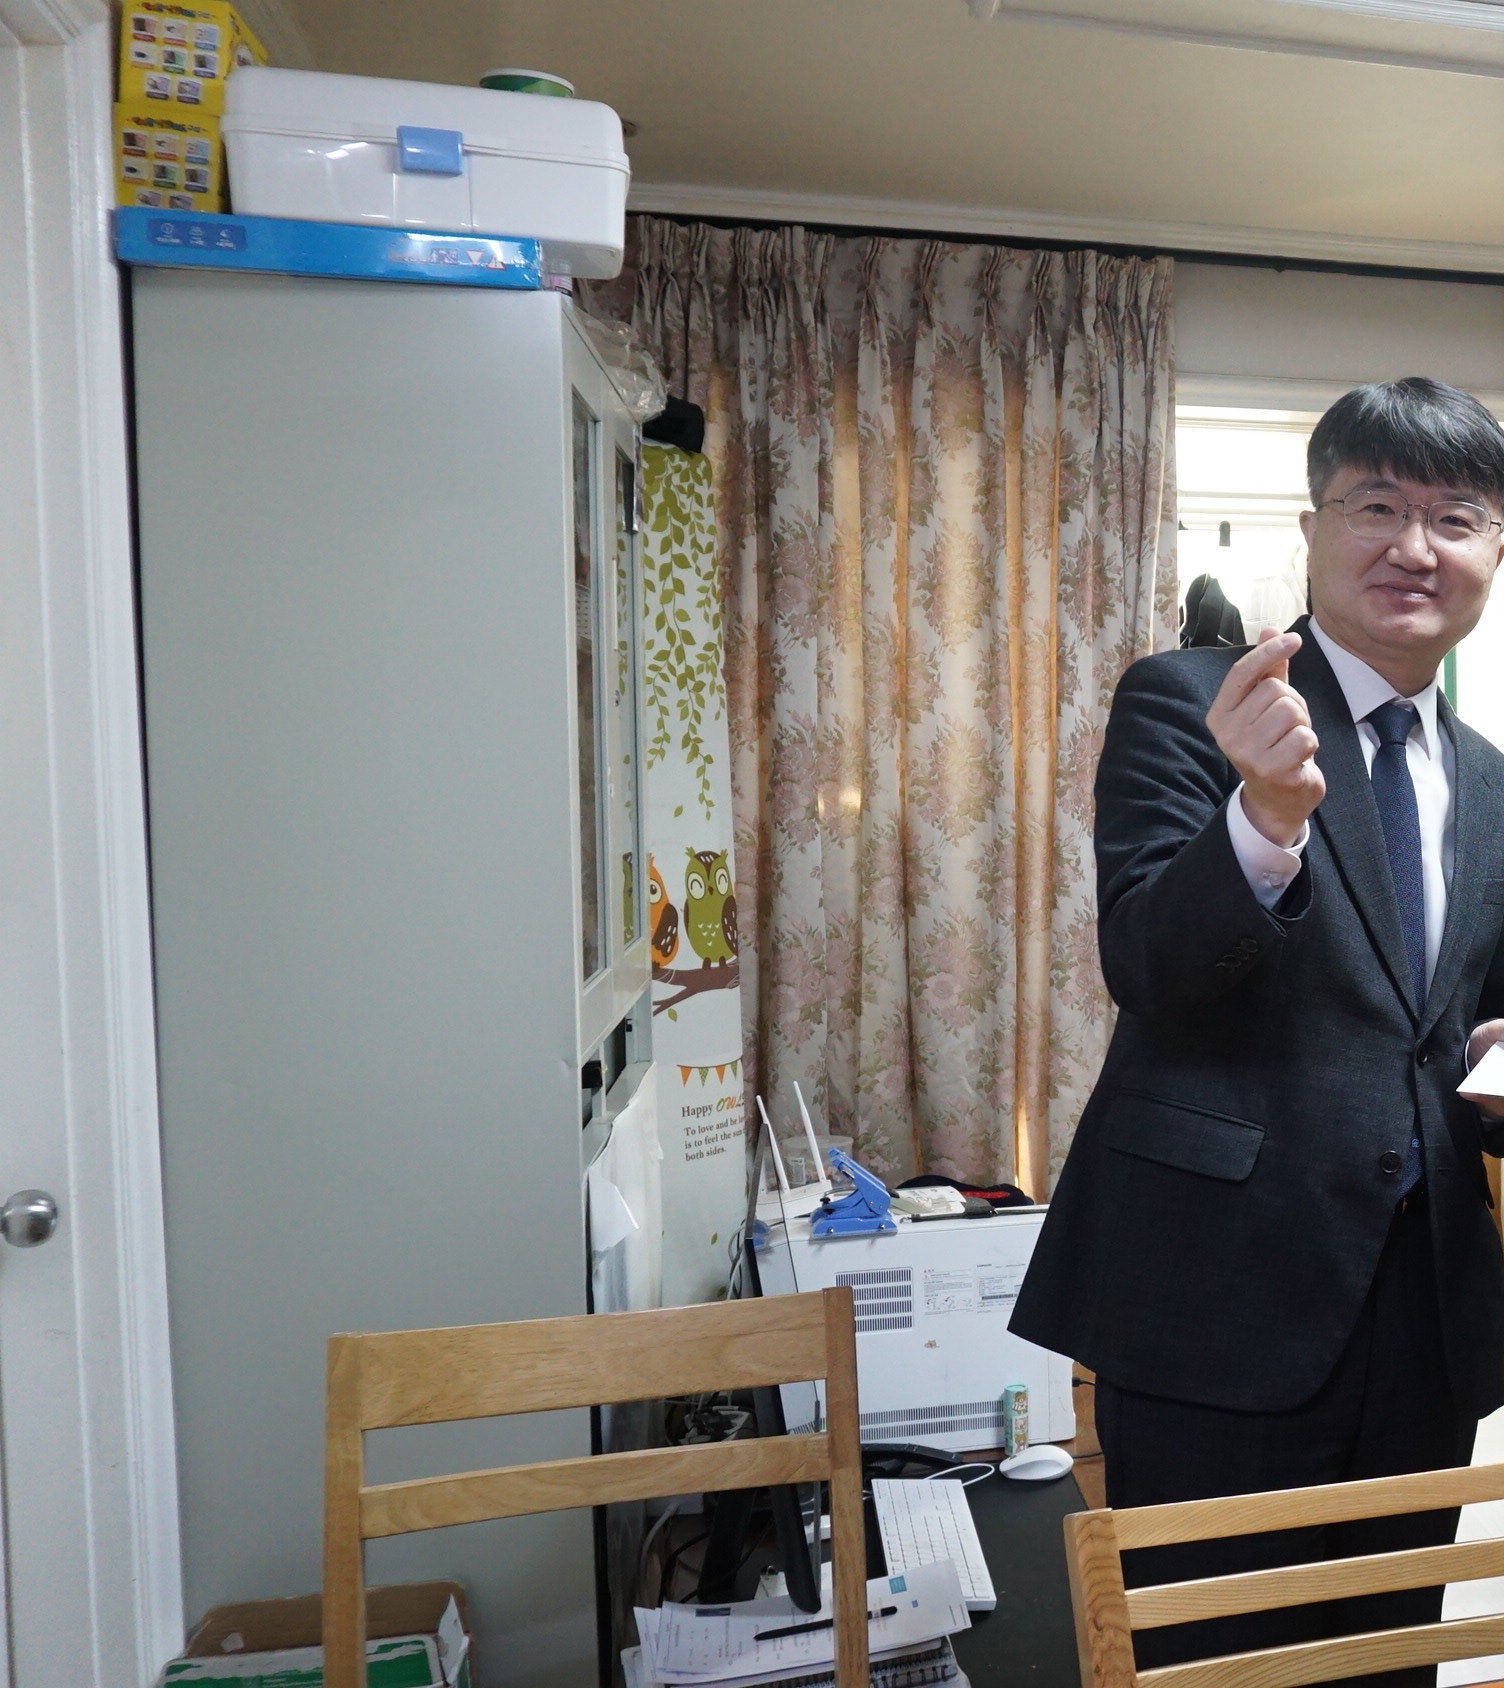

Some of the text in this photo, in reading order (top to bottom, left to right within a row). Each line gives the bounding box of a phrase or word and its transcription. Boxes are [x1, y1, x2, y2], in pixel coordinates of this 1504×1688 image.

[681, 1104, 713, 1119] Happy
[684, 1127, 696, 1137] To
[698, 1124, 714, 1134] love
[716, 1118, 729, 1130] and
[730, 1117, 737, 1126] be
[685, 1140, 692, 1149] is
[694, 1139, 703, 1147] to
[705, 1133, 719, 1145] feel
[720, 1131, 731, 1141] the
[685, 1146, 726, 1162] both sides.
